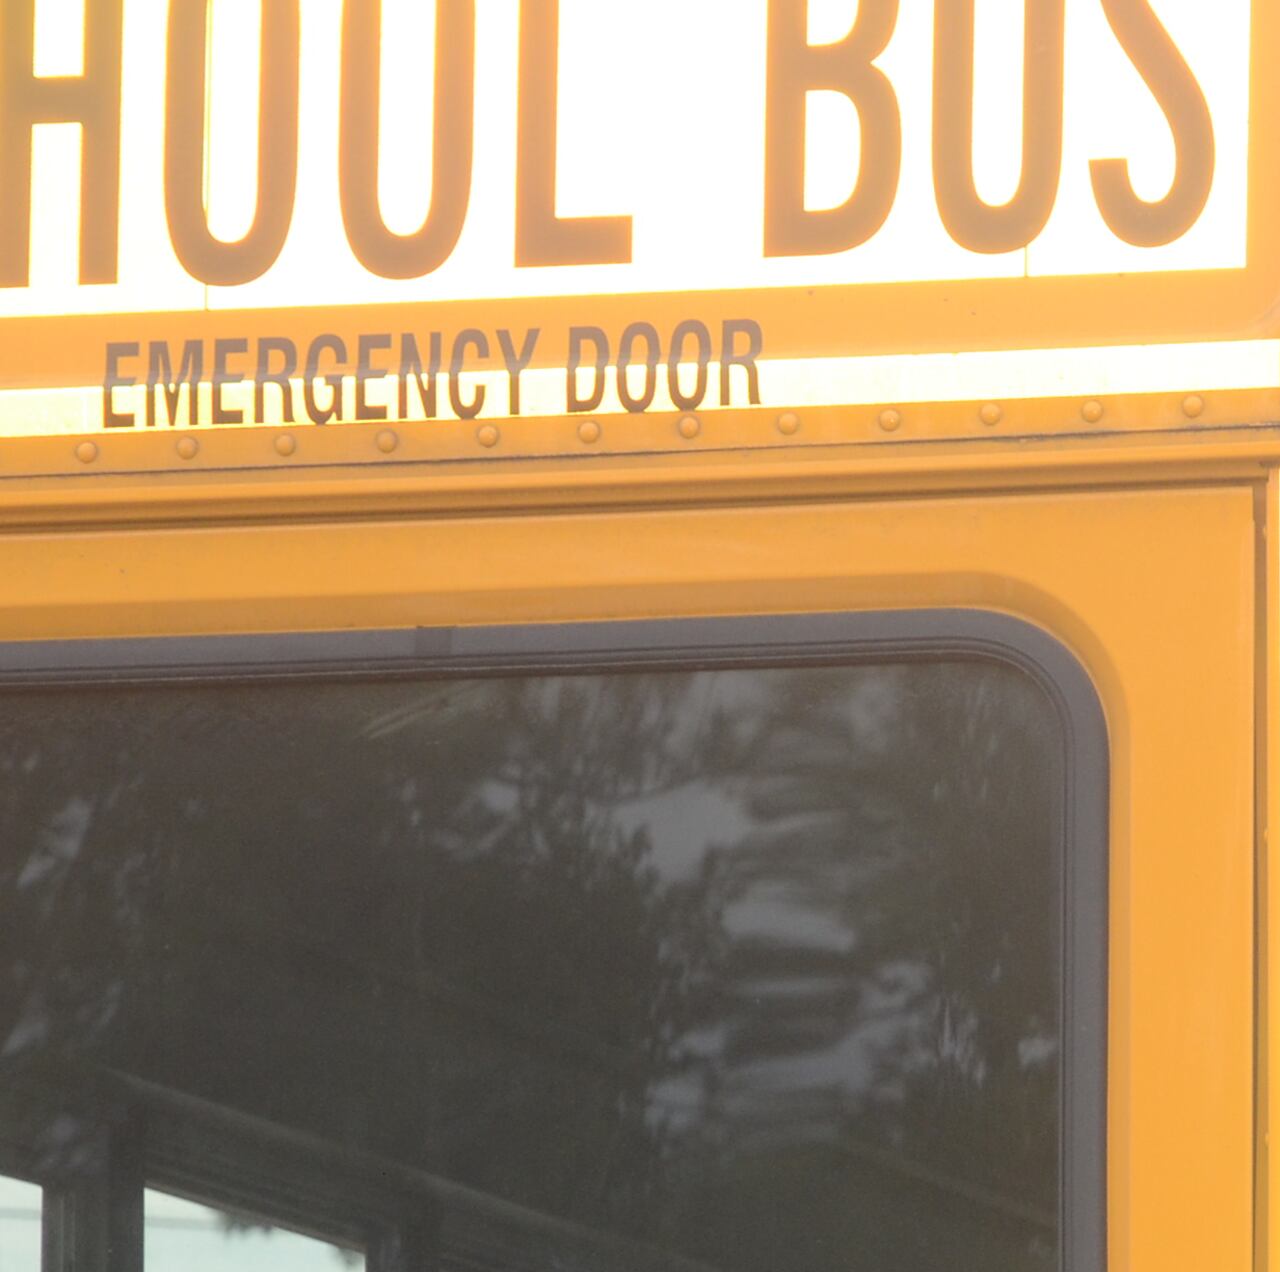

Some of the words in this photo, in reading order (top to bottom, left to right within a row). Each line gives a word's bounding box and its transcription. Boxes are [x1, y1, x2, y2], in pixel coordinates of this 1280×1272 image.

[762, 0, 1216, 258] BUS
[103, 327, 540, 427] EMERGENCY
[566, 319, 763, 413] DOOR
